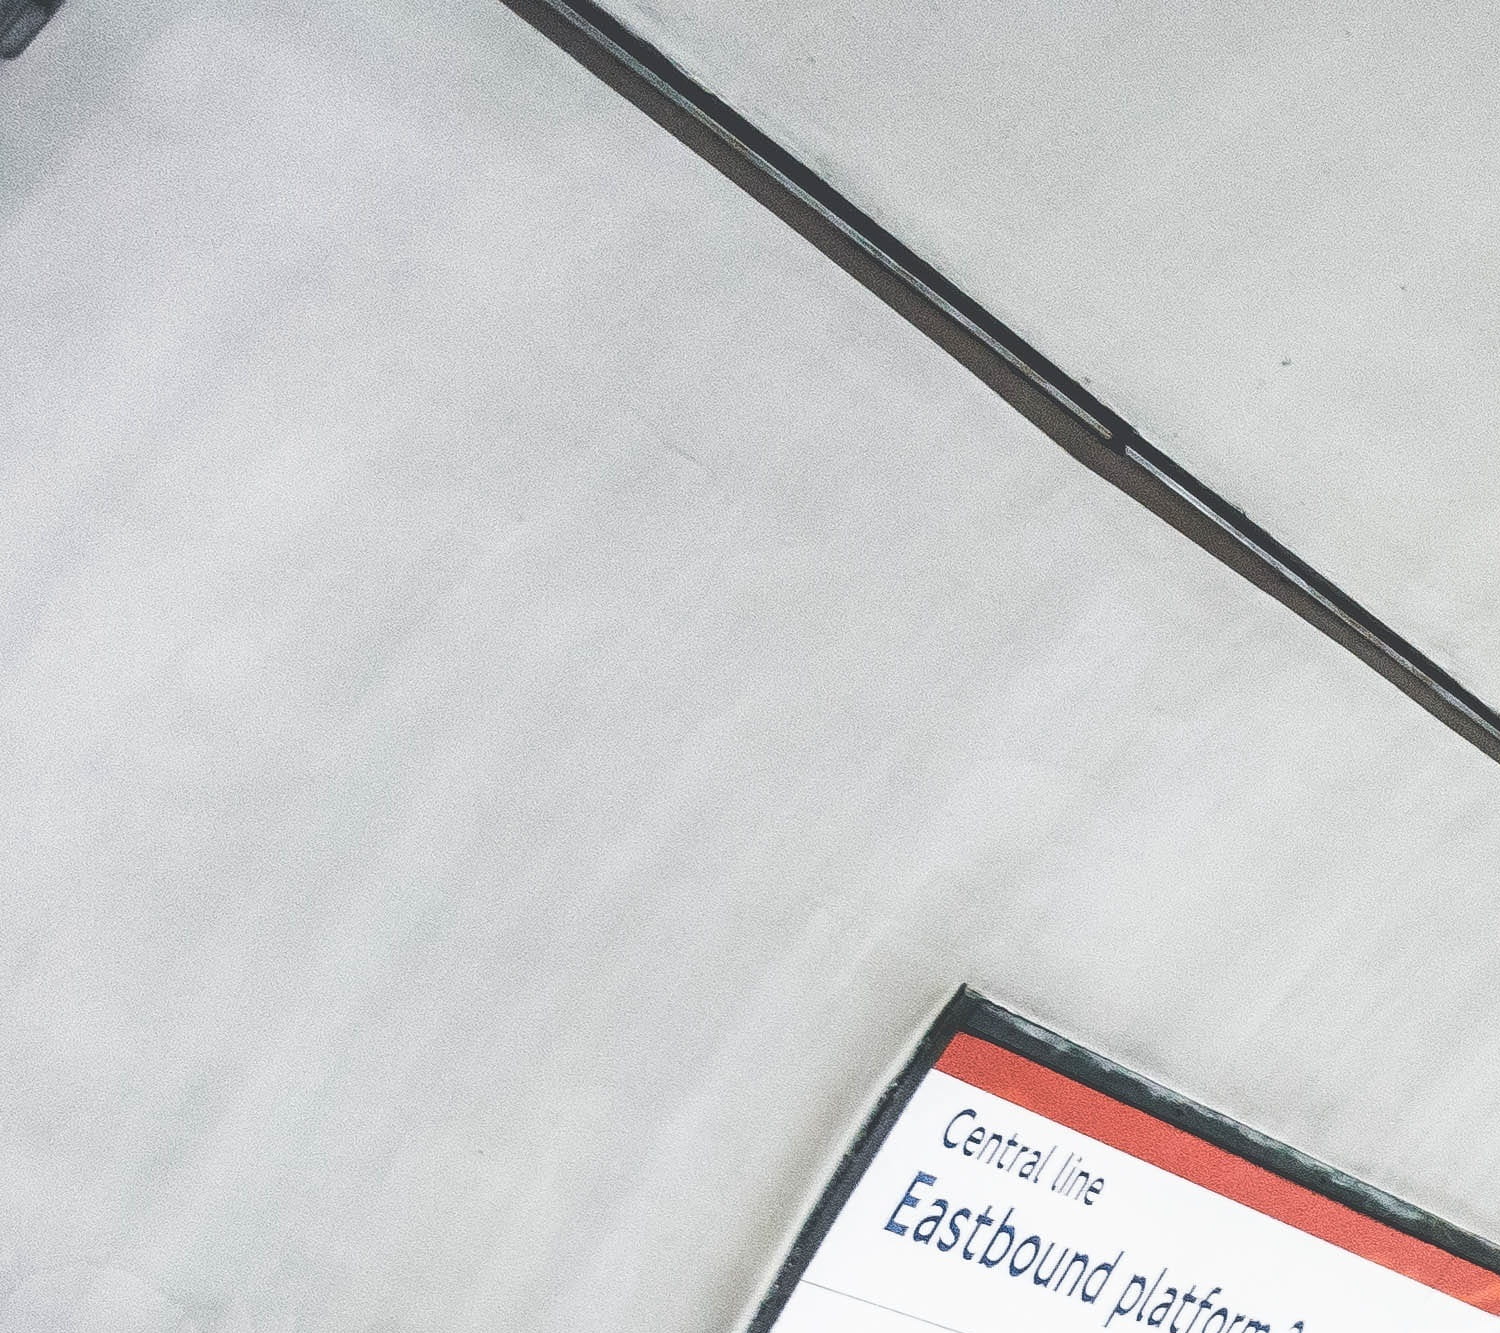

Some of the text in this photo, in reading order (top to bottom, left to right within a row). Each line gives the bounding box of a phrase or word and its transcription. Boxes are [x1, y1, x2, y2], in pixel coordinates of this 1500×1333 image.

[943, 1108, 1105, 1206] Central line
[883, 1171, 1124, 1308] Eastbound
